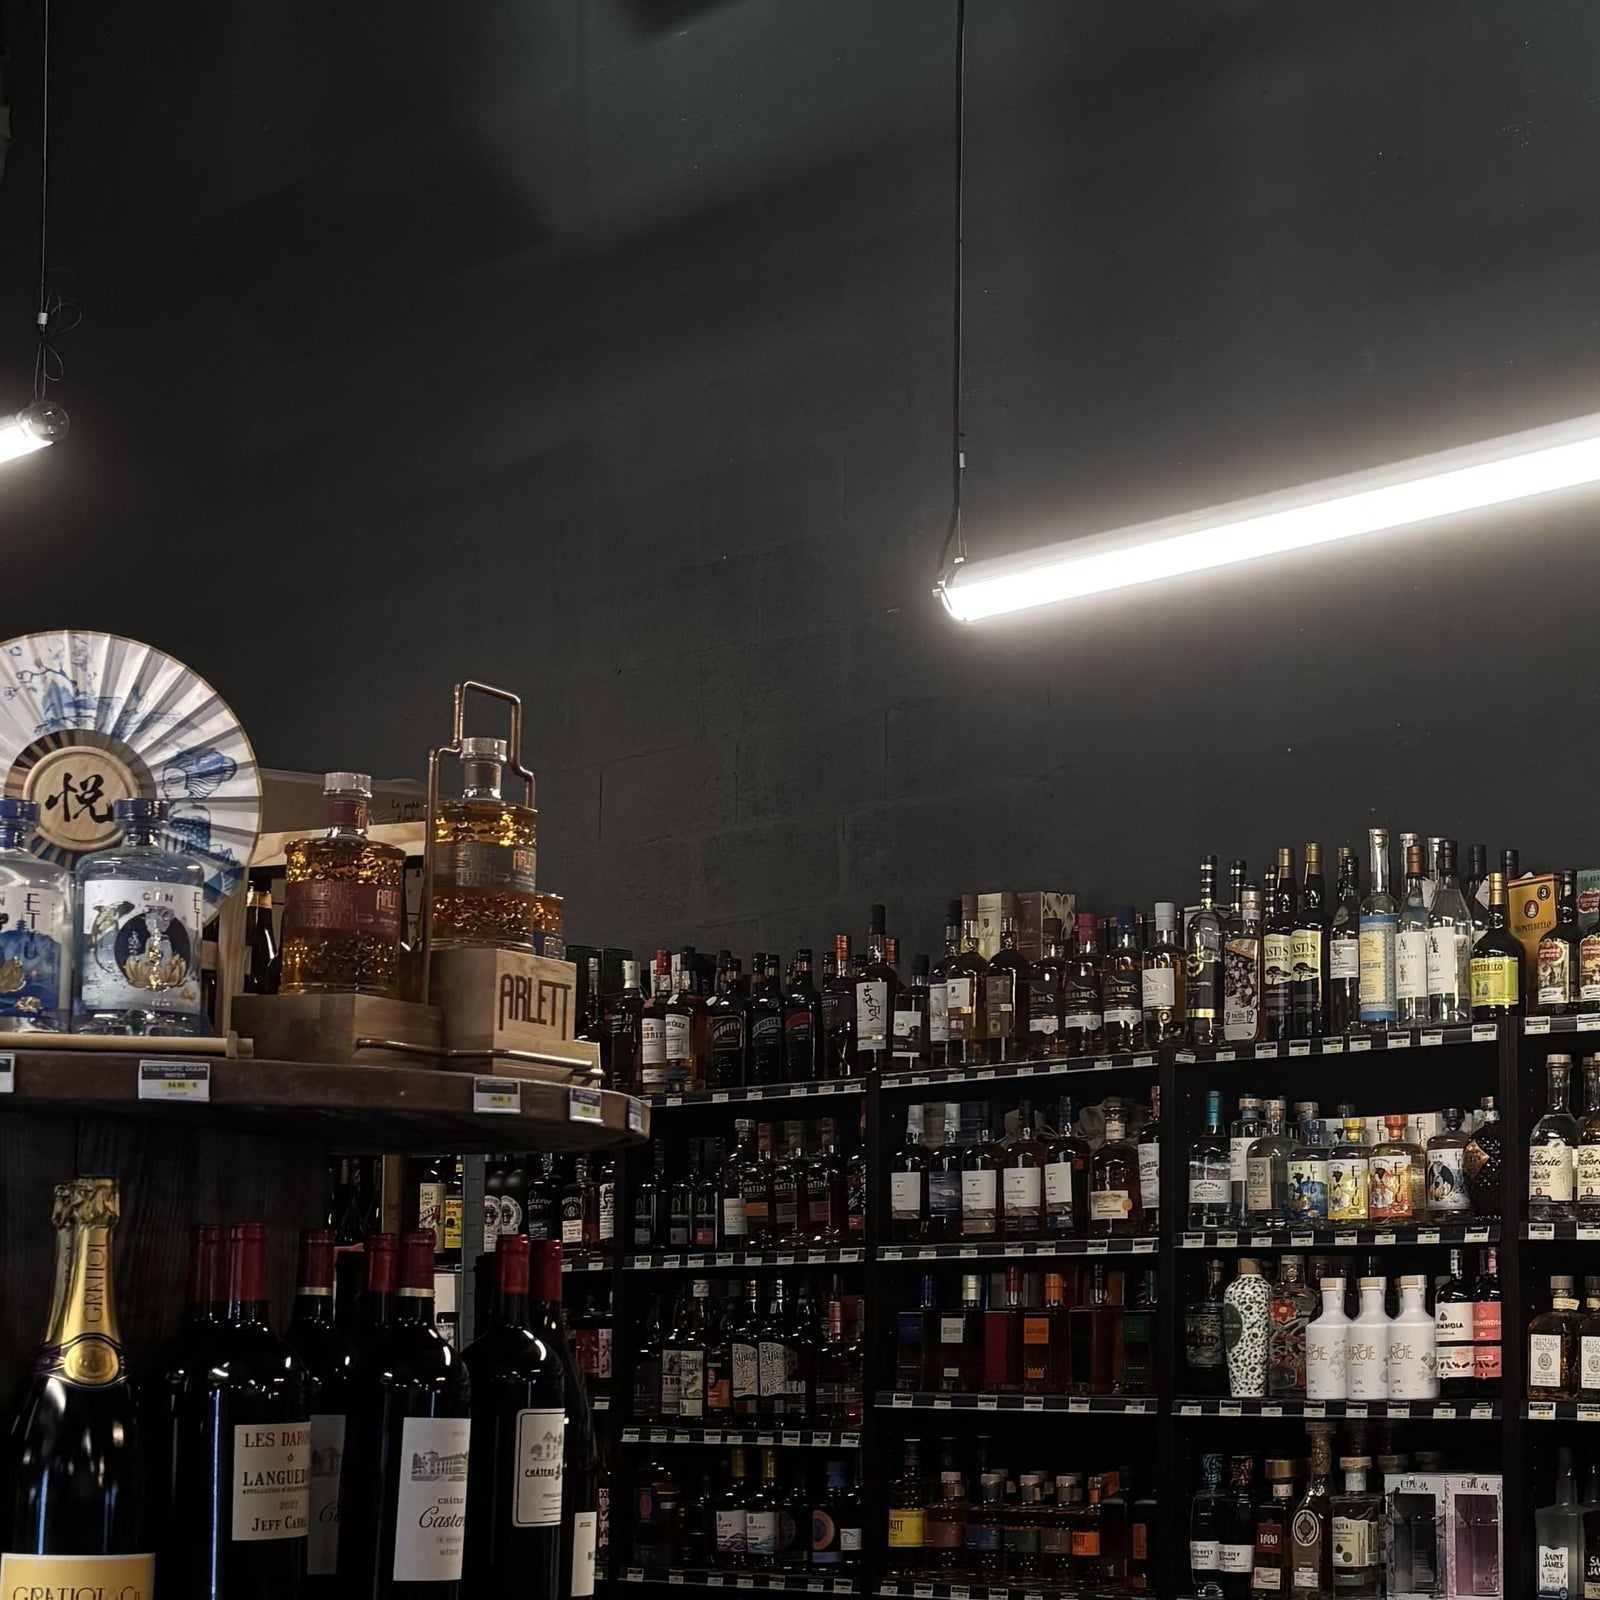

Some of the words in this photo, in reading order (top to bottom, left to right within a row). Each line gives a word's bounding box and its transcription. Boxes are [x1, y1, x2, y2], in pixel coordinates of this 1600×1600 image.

[1265, 943, 1288, 954] ASTIS
[499, 973, 571, 1040] ARLETT
[244, 1432, 275, 1448] LES
[252, 1518, 281, 1531] JEFF
[1258, 1532, 1278, 1545] 1800
